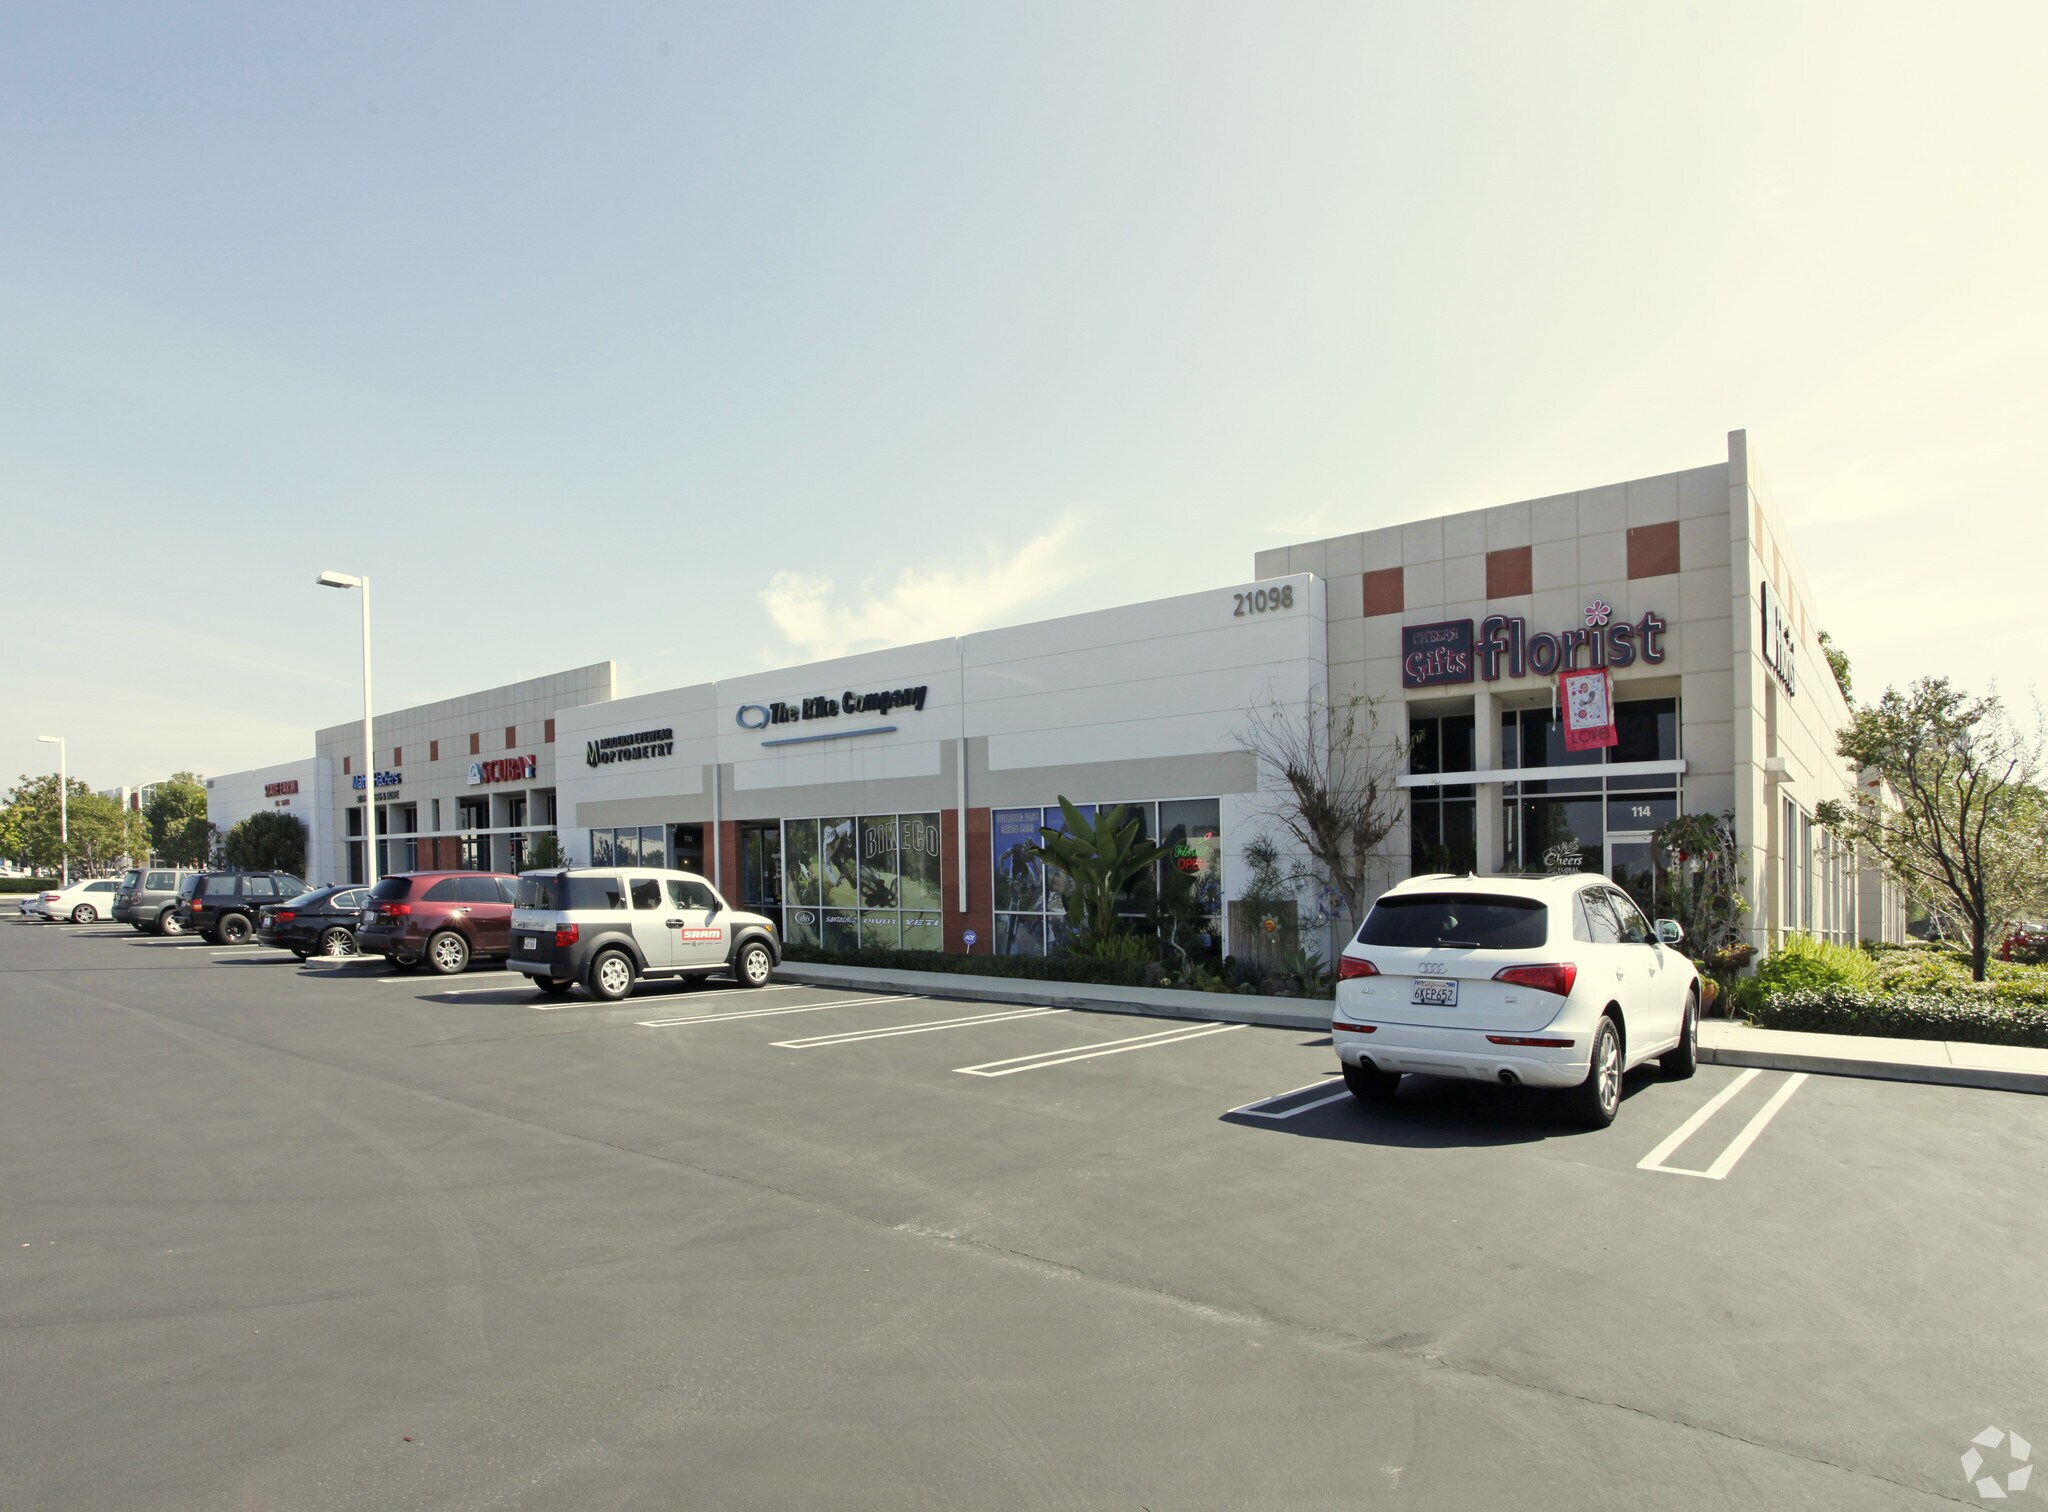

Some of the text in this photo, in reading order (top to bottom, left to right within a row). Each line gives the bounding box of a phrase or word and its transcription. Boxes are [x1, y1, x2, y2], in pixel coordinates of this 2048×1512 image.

[1233, 585, 1294, 617] 21098
[1475, 611, 1667, 681] florist
[1405, 646, 1468, 683] Gifts
[769, 685, 928, 724] The Bike Company
[600, 728, 673, 749] MODERN EYEWEAR
[601, 742, 673, 764] OPTOMETRY
[481, 756, 525, 784] SCUBA
[1631, 806, 1652, 817] 114
[865, 820, 939, 859] BIKECO
[1543, 846, 1583, 867] Cheers
[863, 918, 897, 926] PIVOT
[905, 919, 940, 927] YETI
[683, 930, 721, 939] SRAM
[1414, 988, 1453, 1001] 6KEP652
